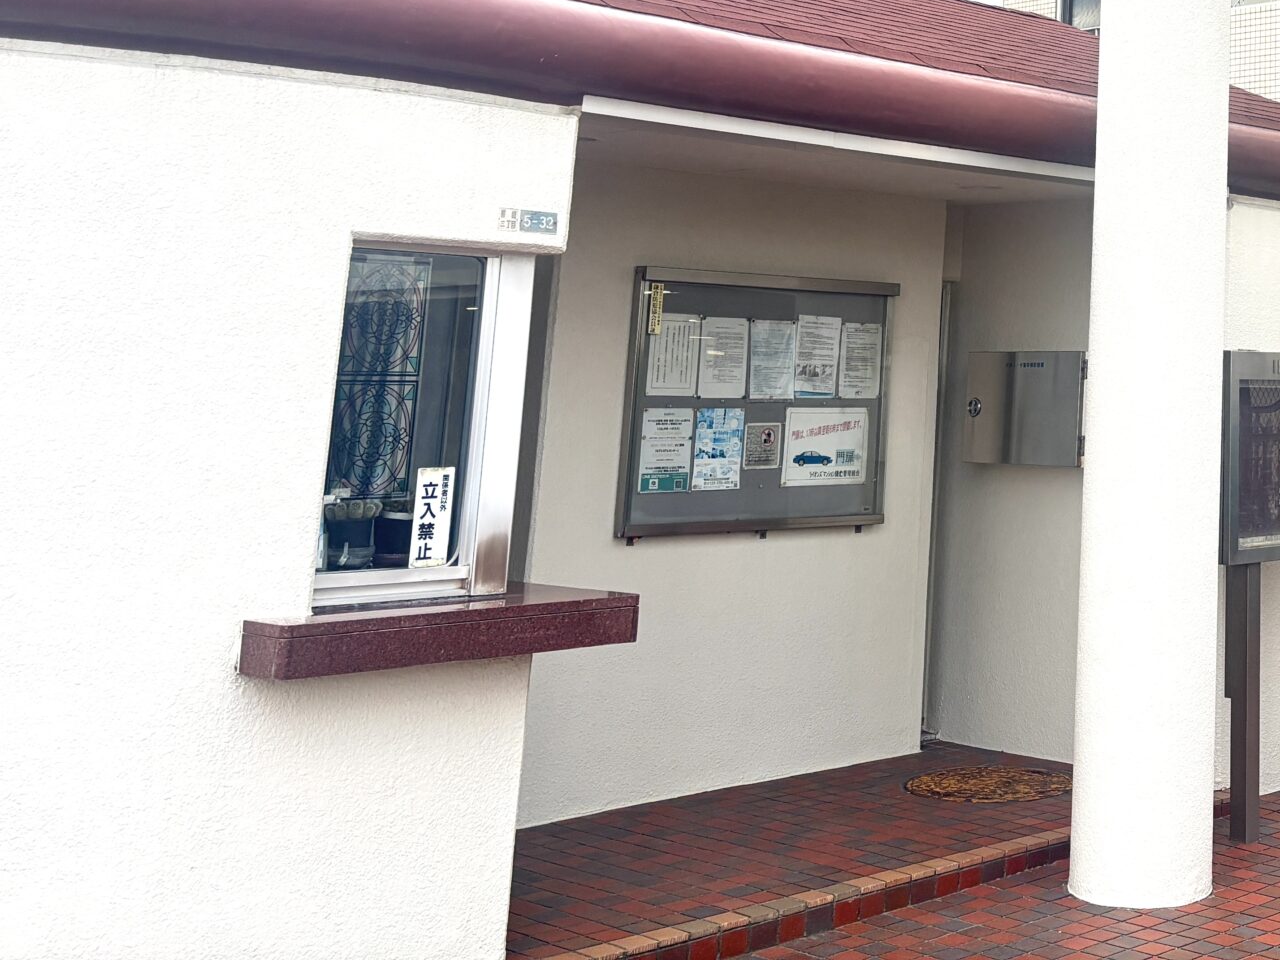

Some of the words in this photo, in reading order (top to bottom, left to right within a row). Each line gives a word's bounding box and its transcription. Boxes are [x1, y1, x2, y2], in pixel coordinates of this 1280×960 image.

[523, 214, 554, 230] 5-32
[440, 474, 450, 512] 関係者以外
[415, 481, 439, 562] 立入禁止
